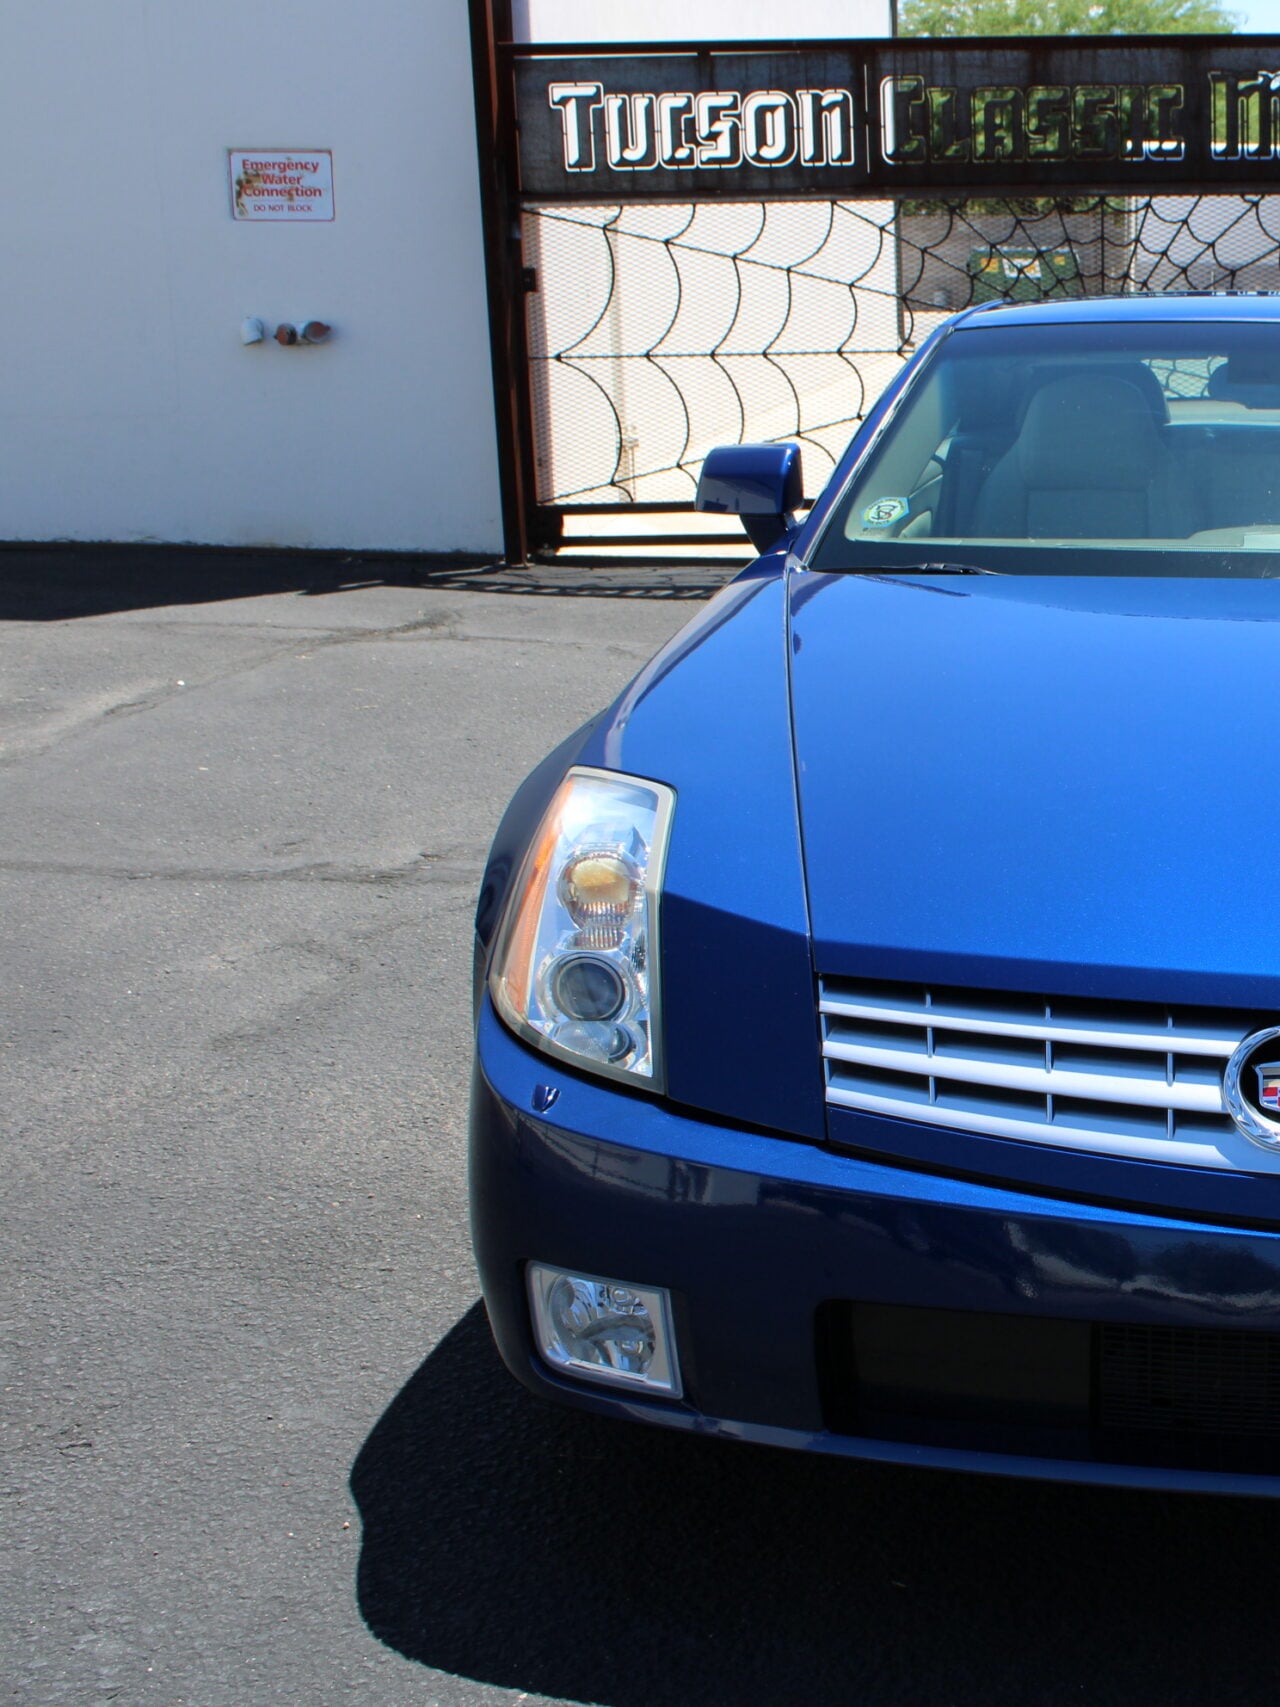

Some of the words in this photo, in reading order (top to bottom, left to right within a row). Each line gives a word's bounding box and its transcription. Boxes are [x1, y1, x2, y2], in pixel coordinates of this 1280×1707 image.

[242, 159, 319, 173] Emergency
[261, 174, 303, 185] Water
[243, 186, 322, 197] Connection
